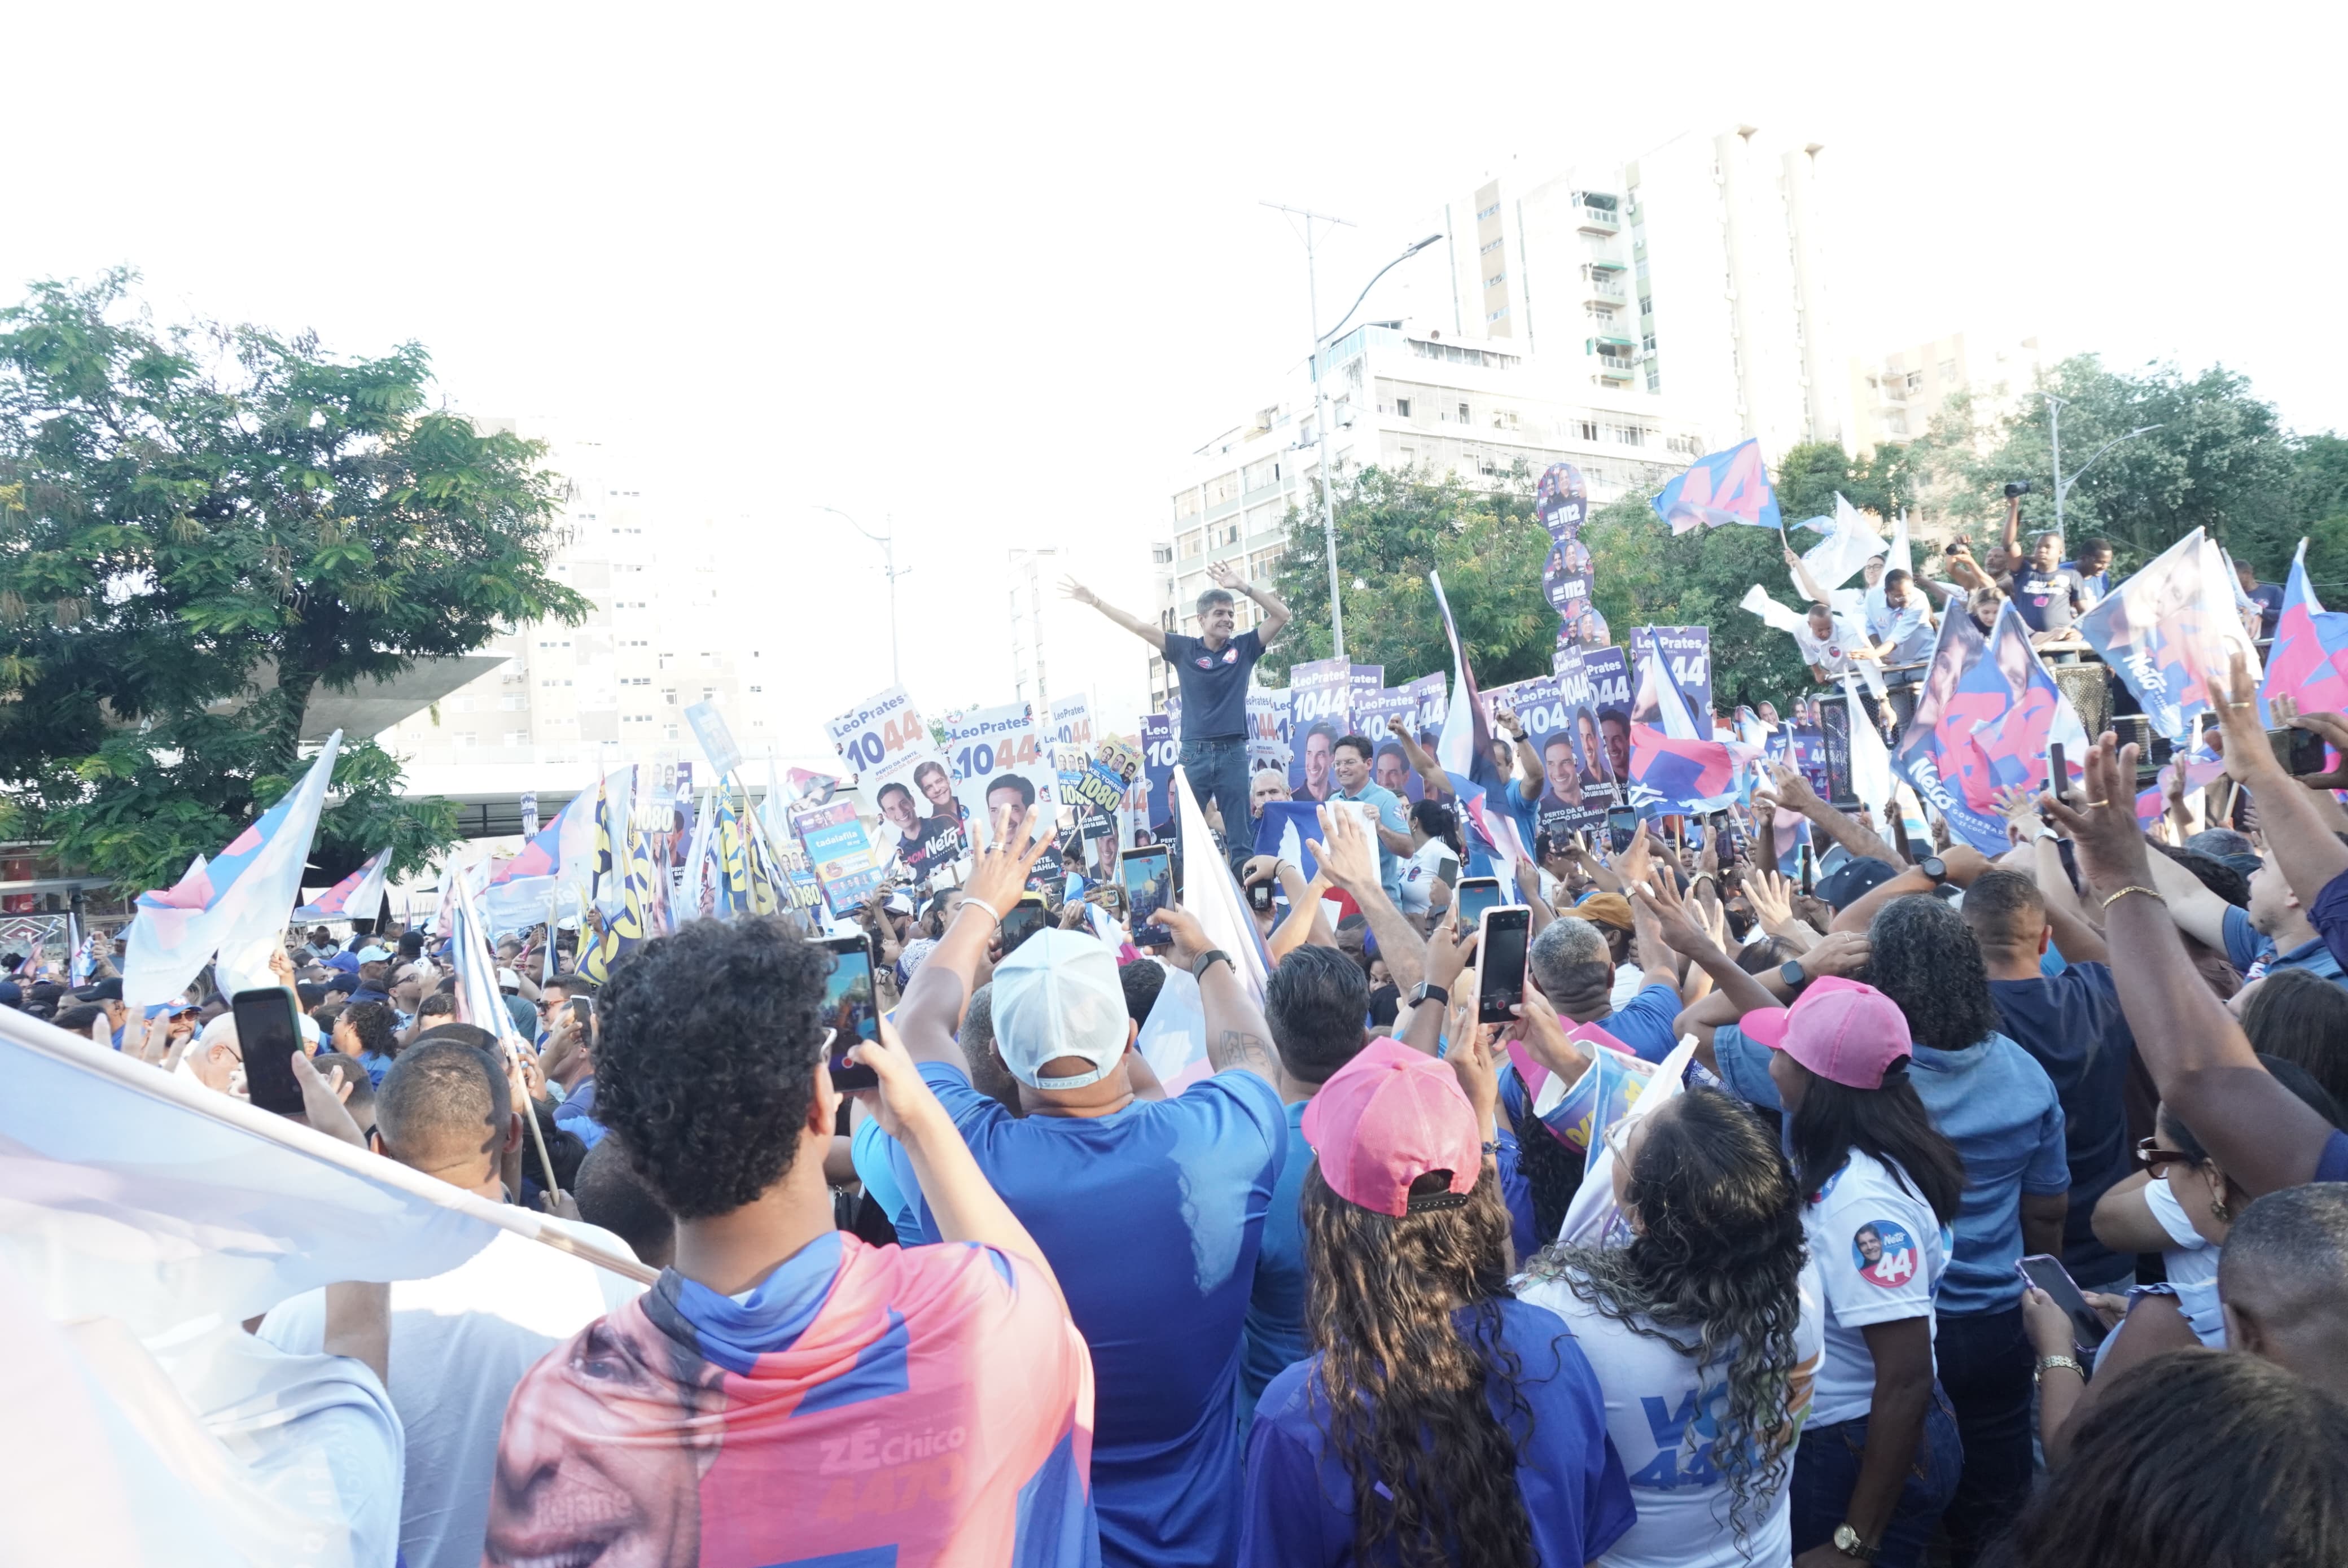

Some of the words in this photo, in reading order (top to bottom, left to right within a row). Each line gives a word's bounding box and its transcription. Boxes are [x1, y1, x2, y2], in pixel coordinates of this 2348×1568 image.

[1637, 656, 1706, 686] 144
[1294, 686, 1346, 722] 1044
[847, 709, 923, 772] 1044
[1247, 713, 1276, 741] 1044
[957, 734, 1037, 778] 1044
[1078, 773, 1120, 811] 1080
[1088, 767, 1101, 778] KEL
[1101, 774, 1125, 795] TORRES
[1908, 757, 1960, 809] Neto
[635, 805, 673, 832] 1080
[1544, 809, 1566, 818] PERTO
[925, 826, 960, 858] Neto
[1883, 1232, 1906, 1246] Neto
[1874, 1247, 1912, 1282] 44
[820, 1421, 881, 1475] ZÉ
[881, 1426, 966, 1466] Chico
